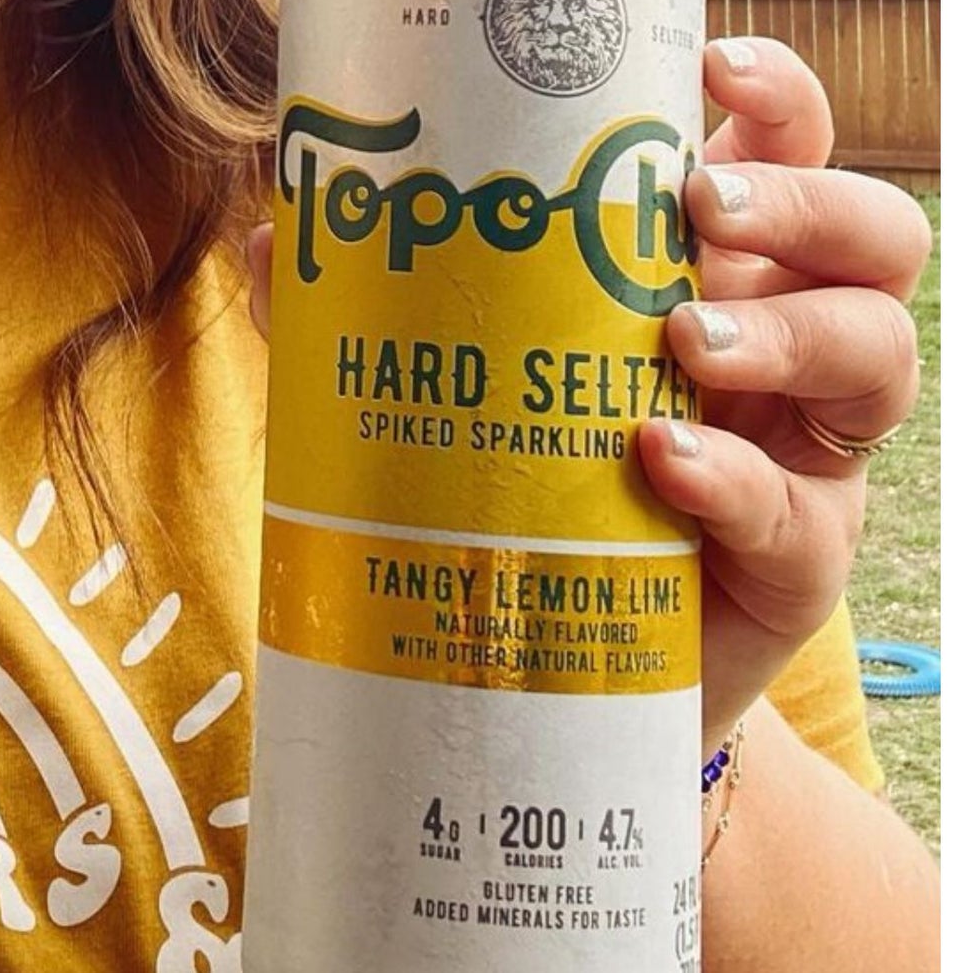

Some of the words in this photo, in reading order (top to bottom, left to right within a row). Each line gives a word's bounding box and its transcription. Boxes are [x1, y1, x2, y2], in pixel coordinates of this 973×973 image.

[402, 7, 451, 26] HARD
[279, 99, 550, 284] Topo
[337, 336, 488, 408] HARD
[360, 411, 455, 448] SPIKED
[471, 421, 625, 460] SPARKLING
[366, 557, 477, 605] TANGY
[496, 571, 615, 615] LEMON
[629, 576, 682, 615] LIME
[435, 611, 546, 640] NATURALLY
[555, 621, 638, 645] FLAVORED
[392, 634, 437, 660] WITH
[446, 642, 507, 667] OTHER
[516, 648, 598, 673] NATURAL
[606, 651, 667, 674] FLAVORS
[499, 805, 566, 851] 200
[598, 808, 644, 851] 4.7%
[420, 842, 461, 861] SUGAR
[504, 853, 564, 870] CALORIES
[413, 897, 469, 923] ADDED
[476, 905, 564, 929] MINERALS
[571, 909, 600, 929] FOR
[607, 907, 647, 927] TASTE
[483, 881, 549, 904] GLUTEN
[556, 885, 594, 905] FREE
